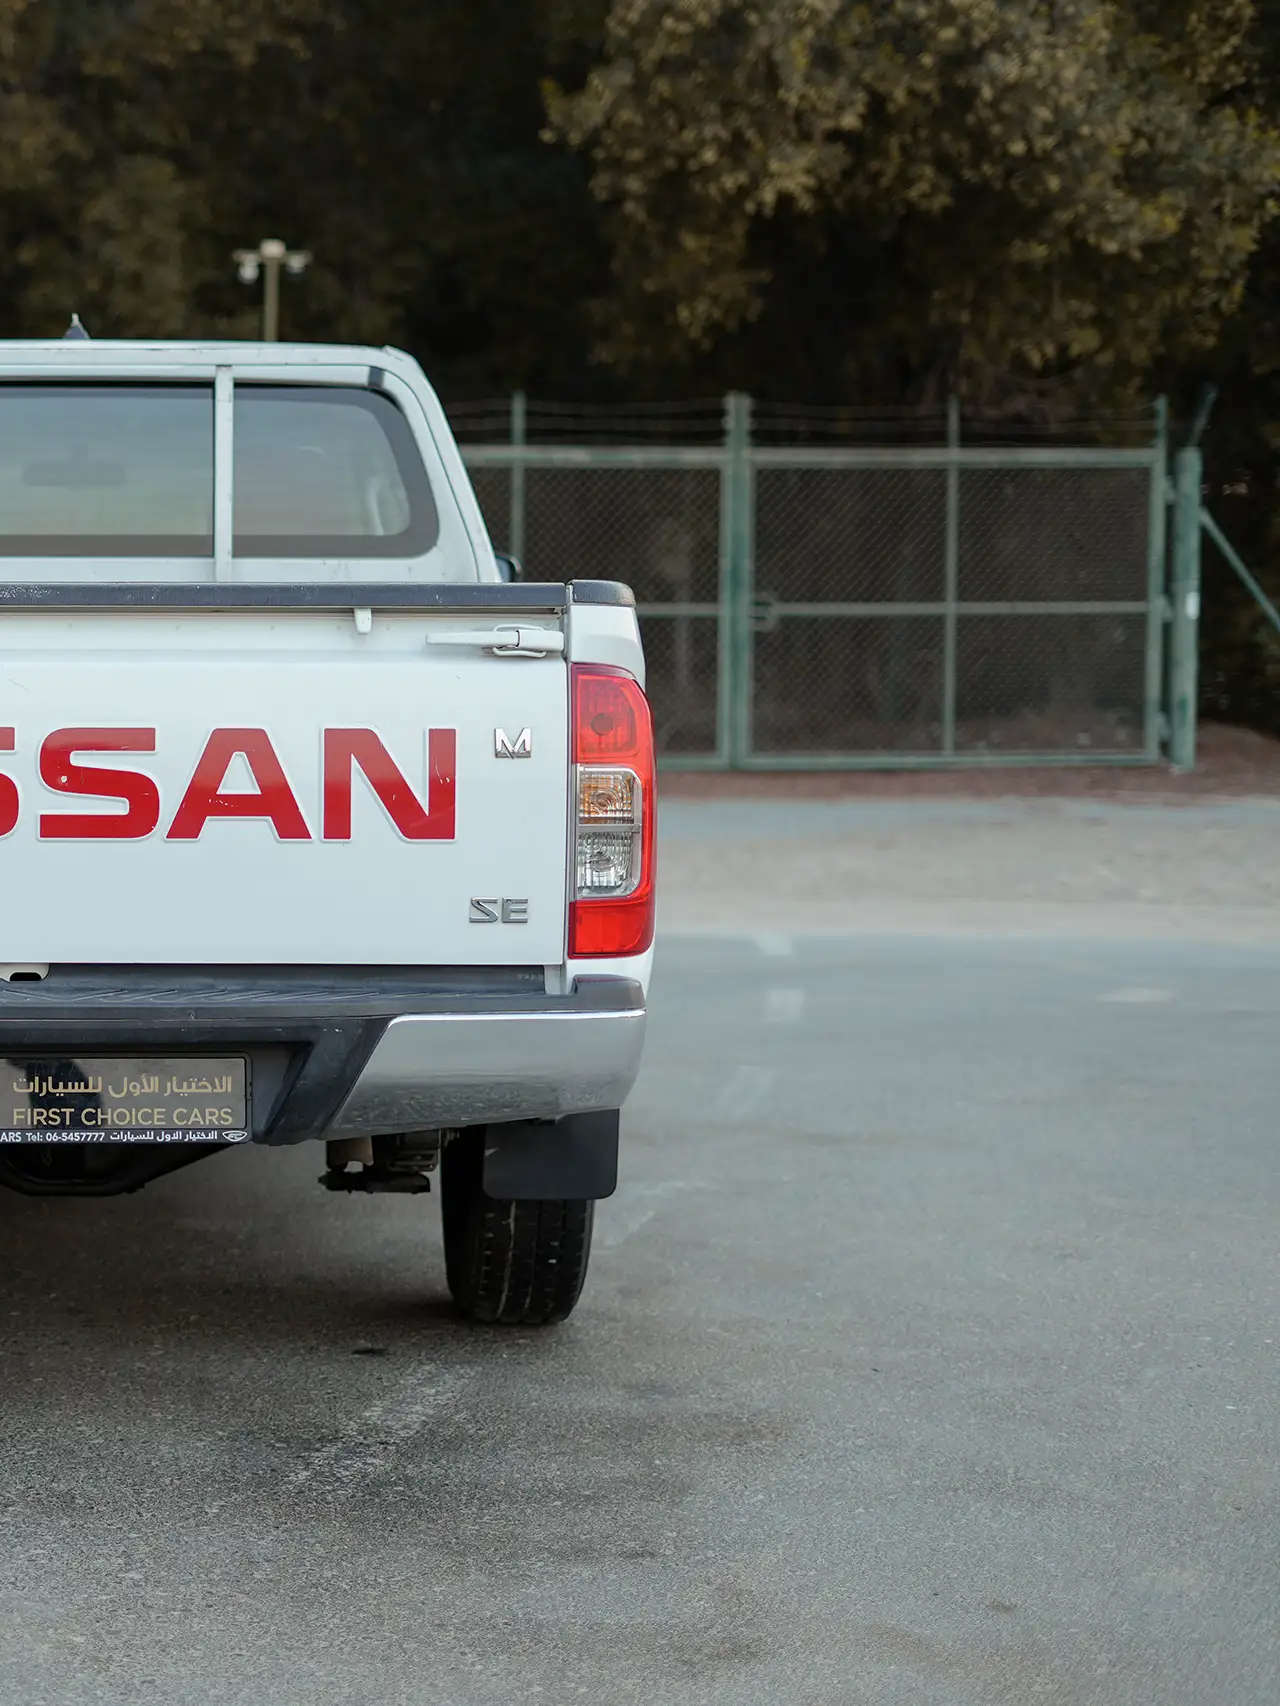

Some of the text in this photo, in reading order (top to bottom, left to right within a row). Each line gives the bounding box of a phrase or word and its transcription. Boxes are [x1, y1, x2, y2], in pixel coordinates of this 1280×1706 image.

[494, 727, 532, 759] M
[469, 897, 529, 924] SE
[12, 1073, 233, 1099] الاختيار الأول للسيارات
[12, 1108, 233, 1126] FIRST CHOICE CARS
[25, 1132, 43, 1142] Tel:
[45, 1132, 105, 1142] 06-5457777
[109, 1131, 154, 1142] للسيارات
[184, 1131, 218, 1142] الاختيار
